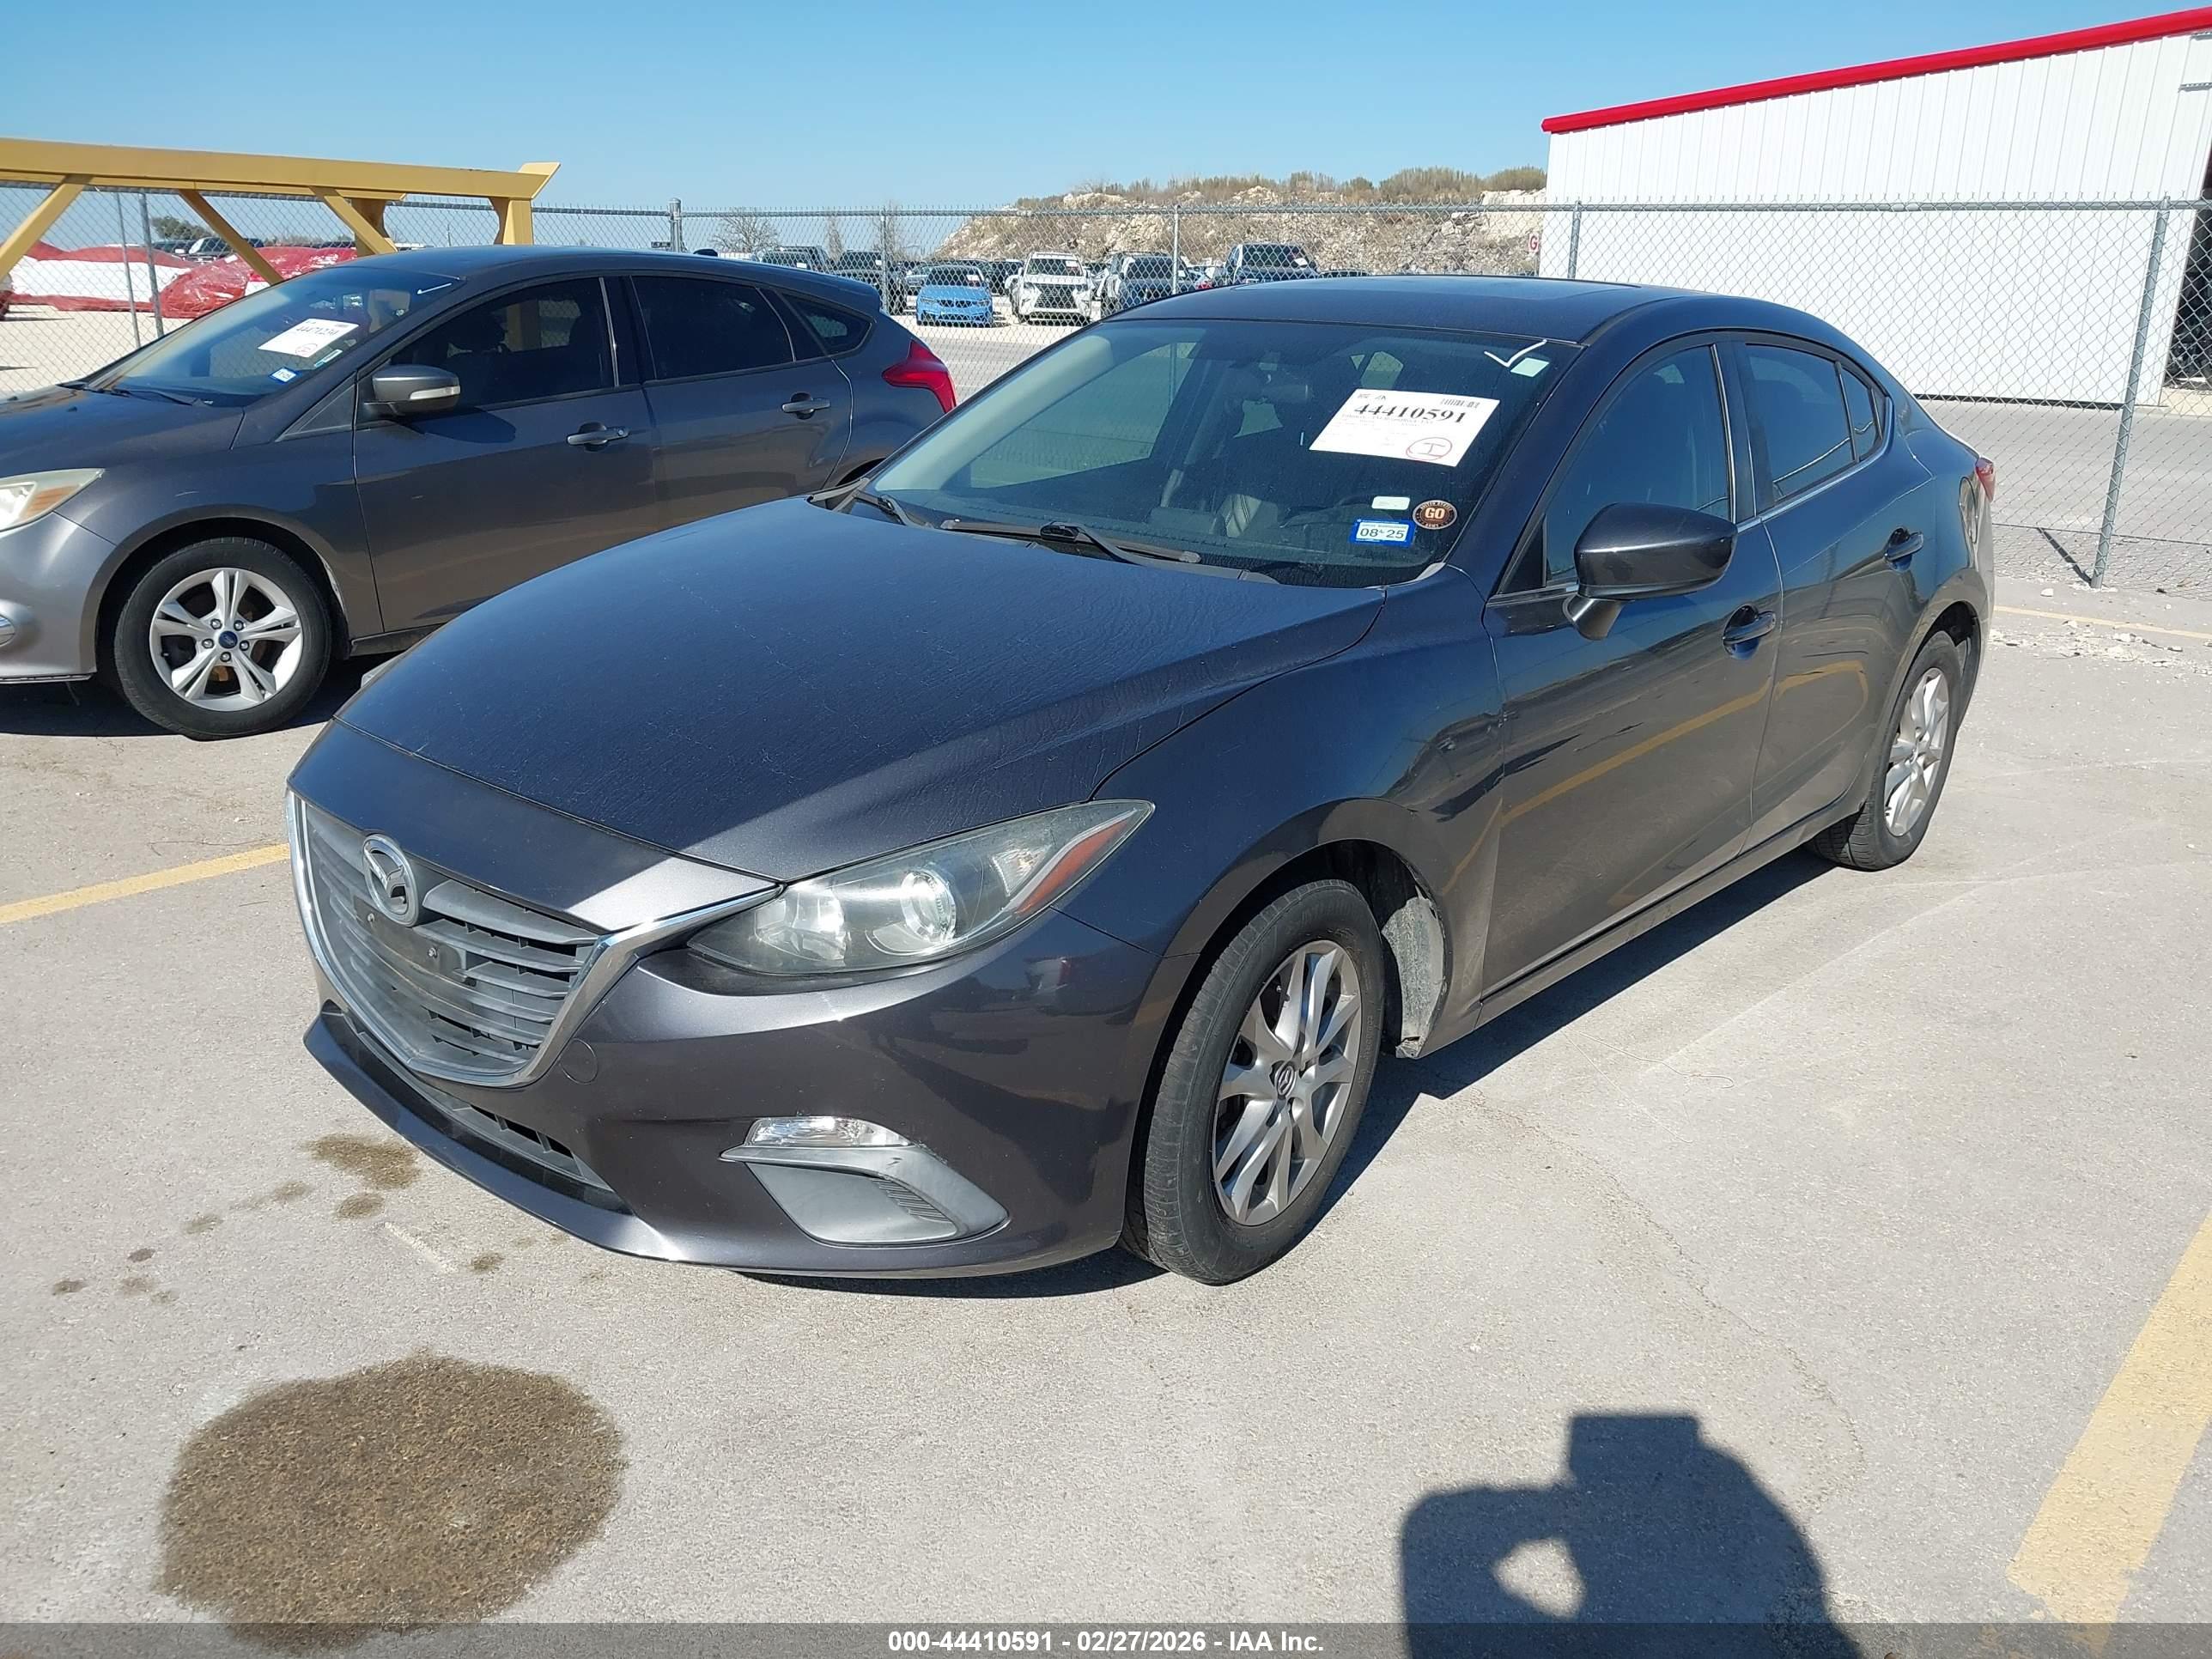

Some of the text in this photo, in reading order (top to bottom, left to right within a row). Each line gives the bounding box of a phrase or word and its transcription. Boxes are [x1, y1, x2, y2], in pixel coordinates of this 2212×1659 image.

[1529, 235, 1538, 251] G
[1354, 404, 1466, 423] 44410591
[1425, 507, 1445, 520] GO
[1359, 528, 1406, 539] 08 25
